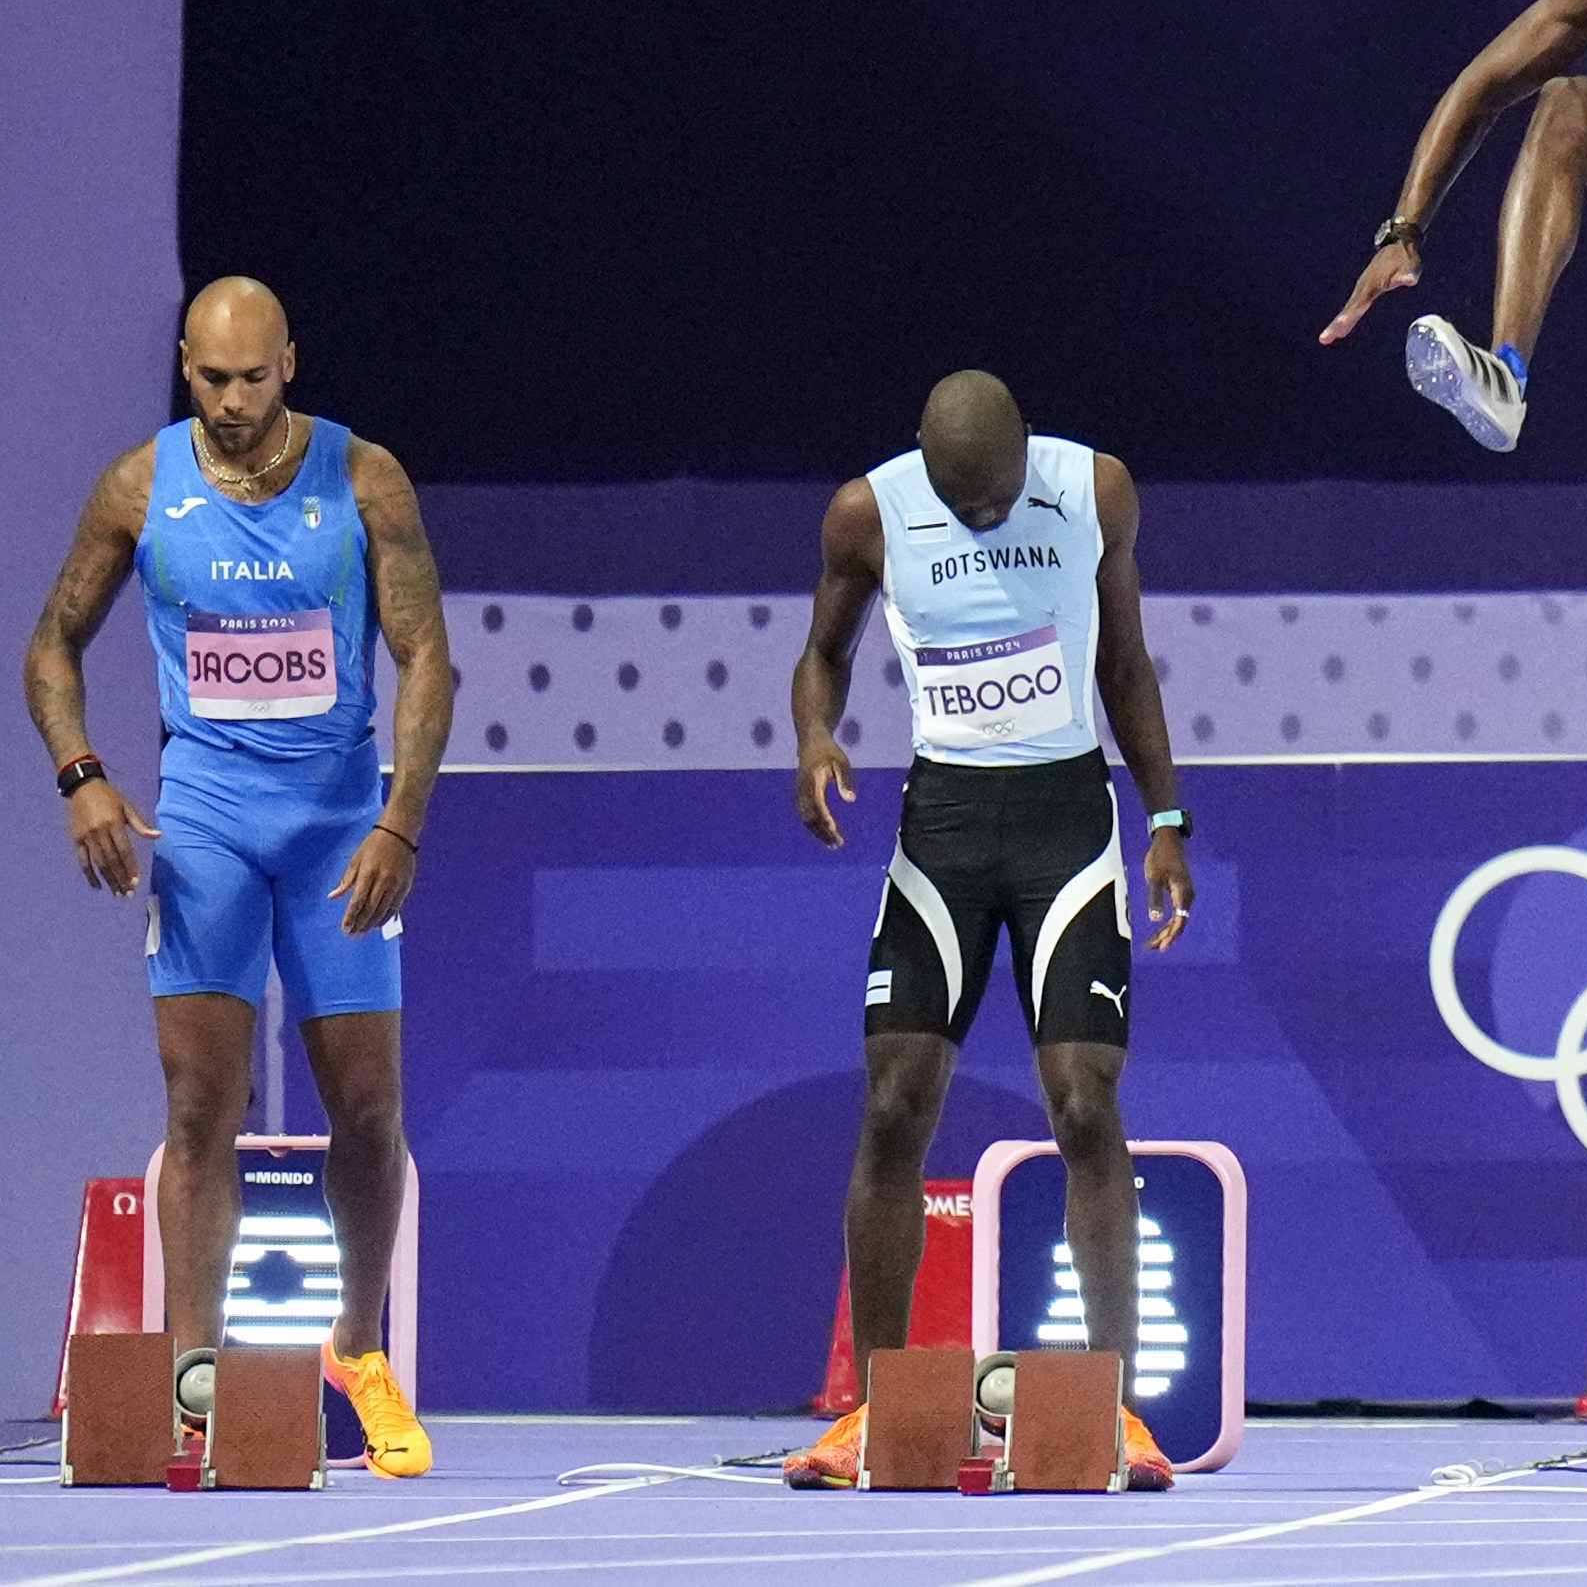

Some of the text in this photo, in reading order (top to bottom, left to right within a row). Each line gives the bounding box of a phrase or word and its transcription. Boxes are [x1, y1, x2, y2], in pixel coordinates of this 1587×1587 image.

[211, 561, 294, 580] ITALIA
[931, 546, 1062, 585] BOTSWANA
[220, 617, 296, 629] PARIS 2024
[946, 640, 1021, 662] PARIS 2024
[191, 648, 327, 684] JACOBS
[923, 665, 1062, 716] TEBOGO
[255, 1171, 314, 1185] MONDO
